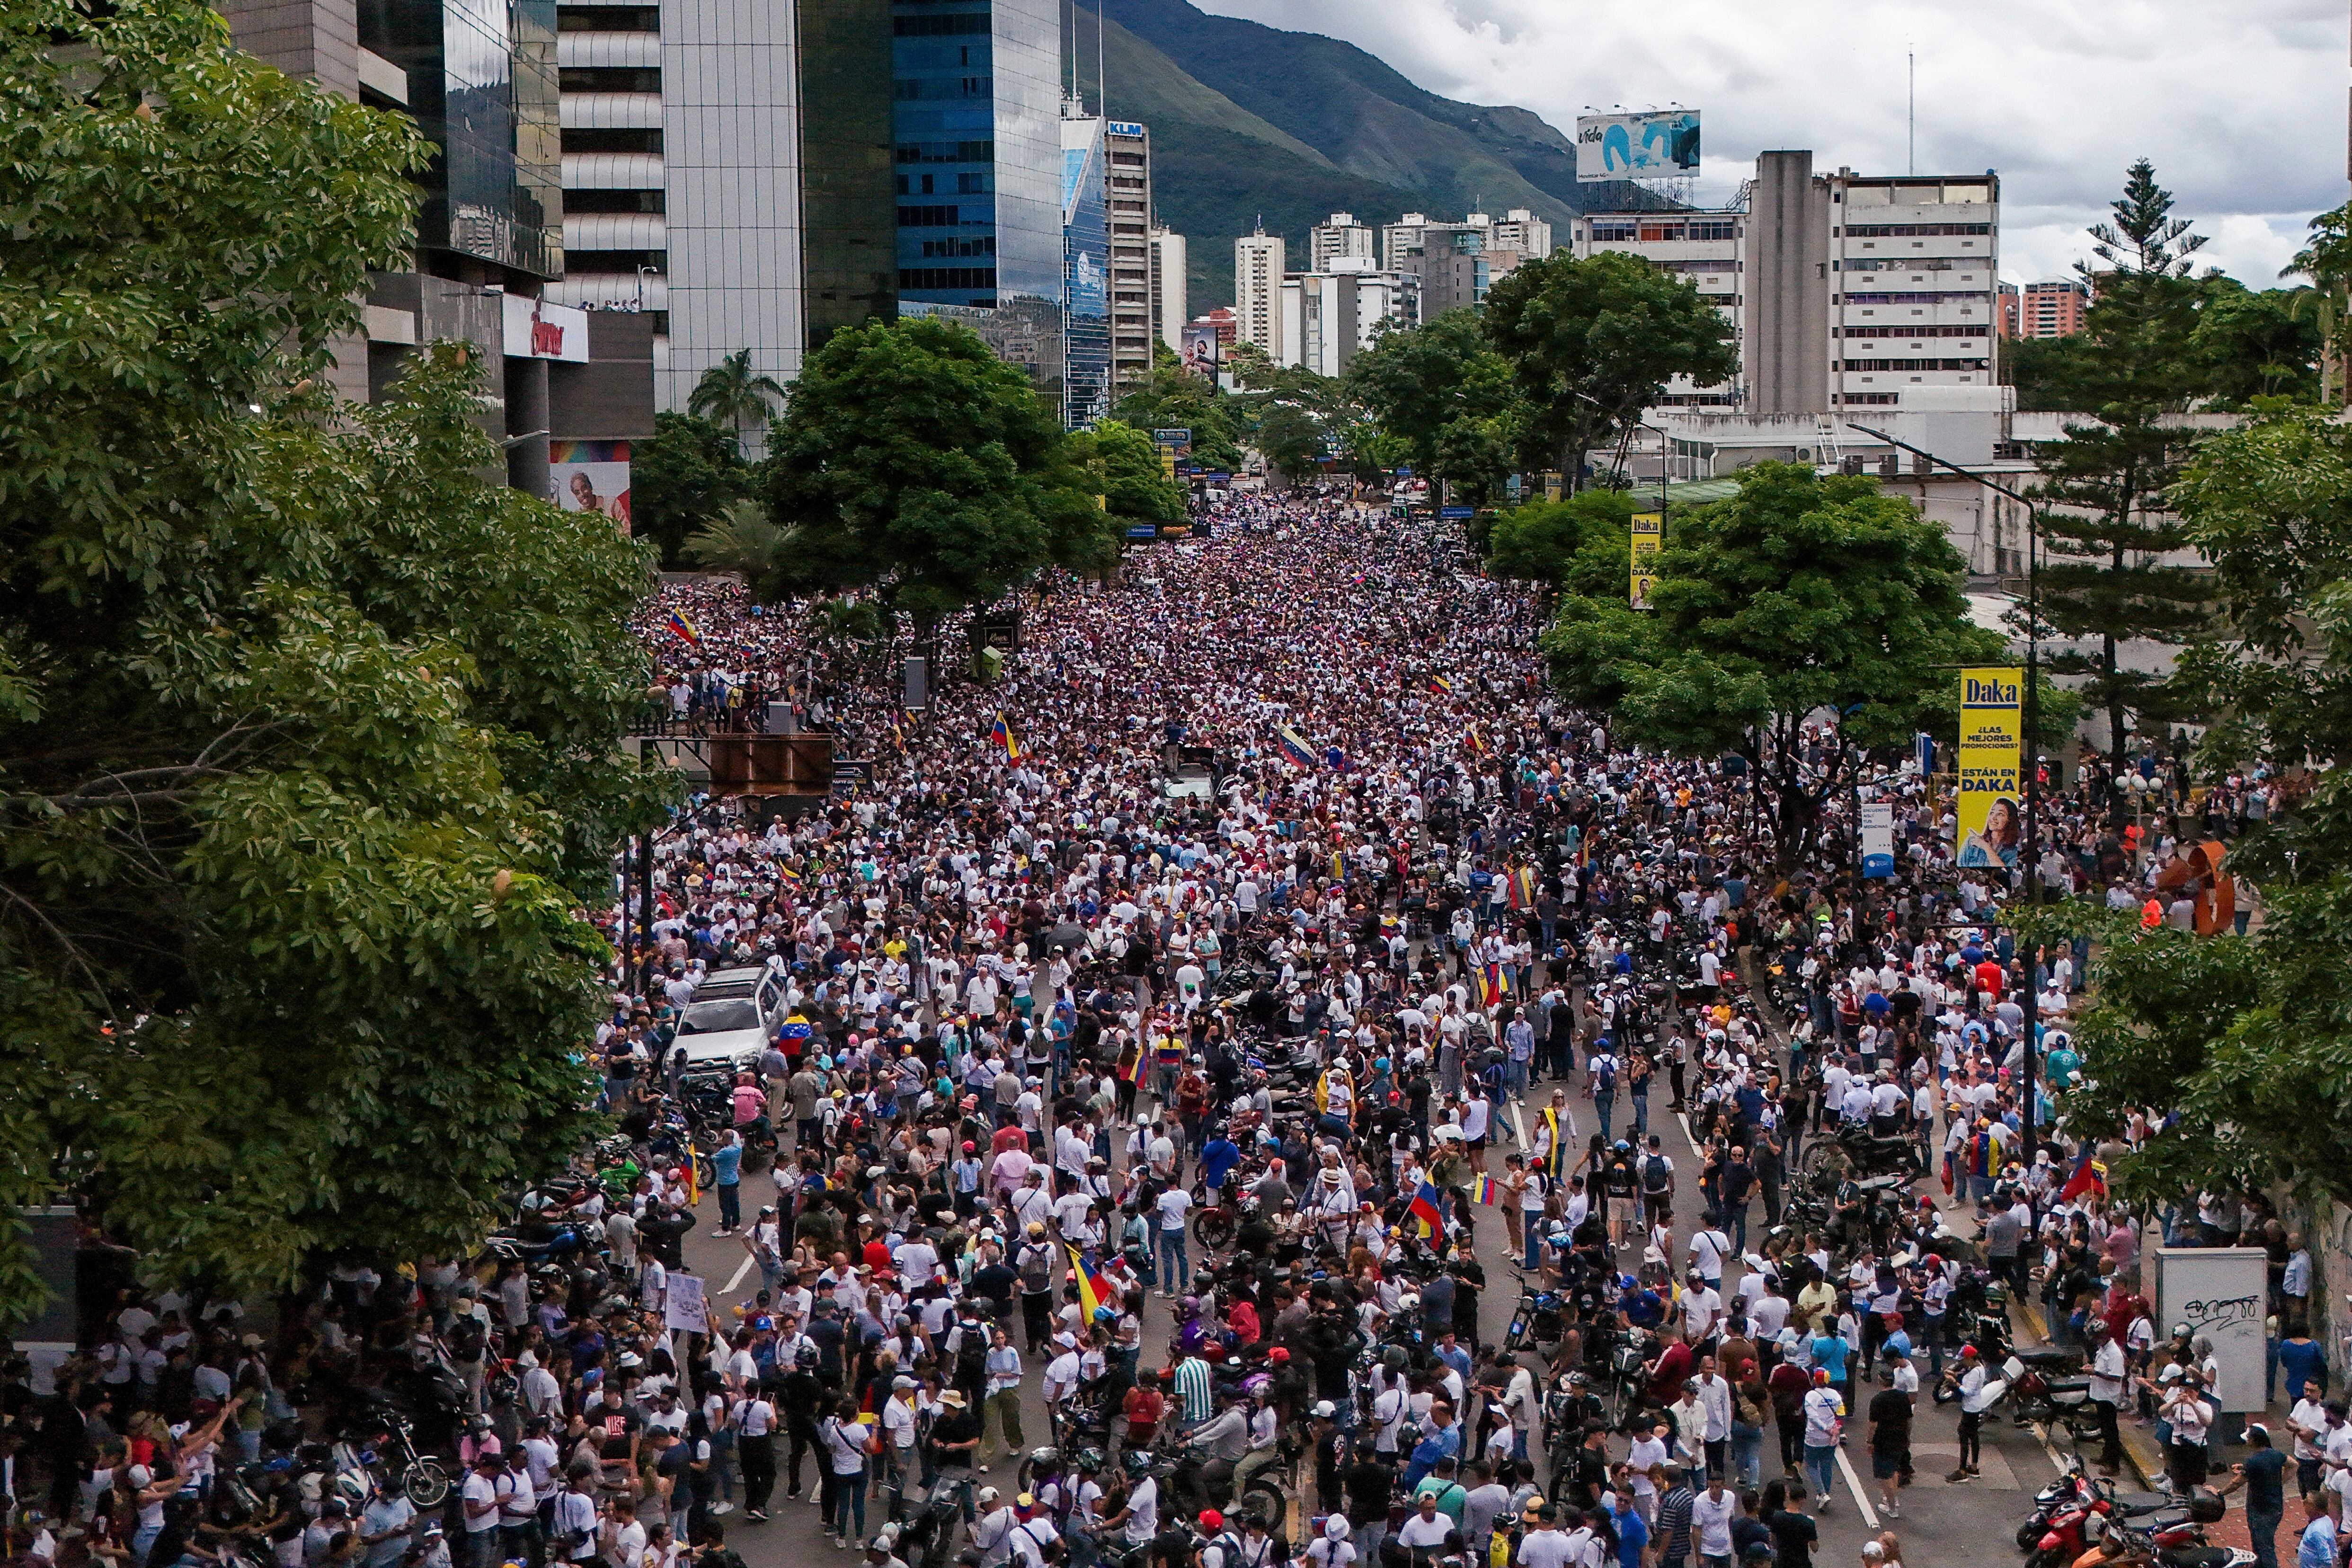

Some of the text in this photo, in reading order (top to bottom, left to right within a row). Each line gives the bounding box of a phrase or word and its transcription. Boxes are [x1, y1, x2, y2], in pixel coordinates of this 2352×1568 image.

[1109, 123, 1141, 135] KLM
[1578, 126, 1603, 143] vida
[1634, 519, 1658, 531] Daka
[1966, 679, 2017, 702] Daka
[1961, 767, 2015, 777] ESTÁN EN
[1961, 779, 2015, 792] DAKA
